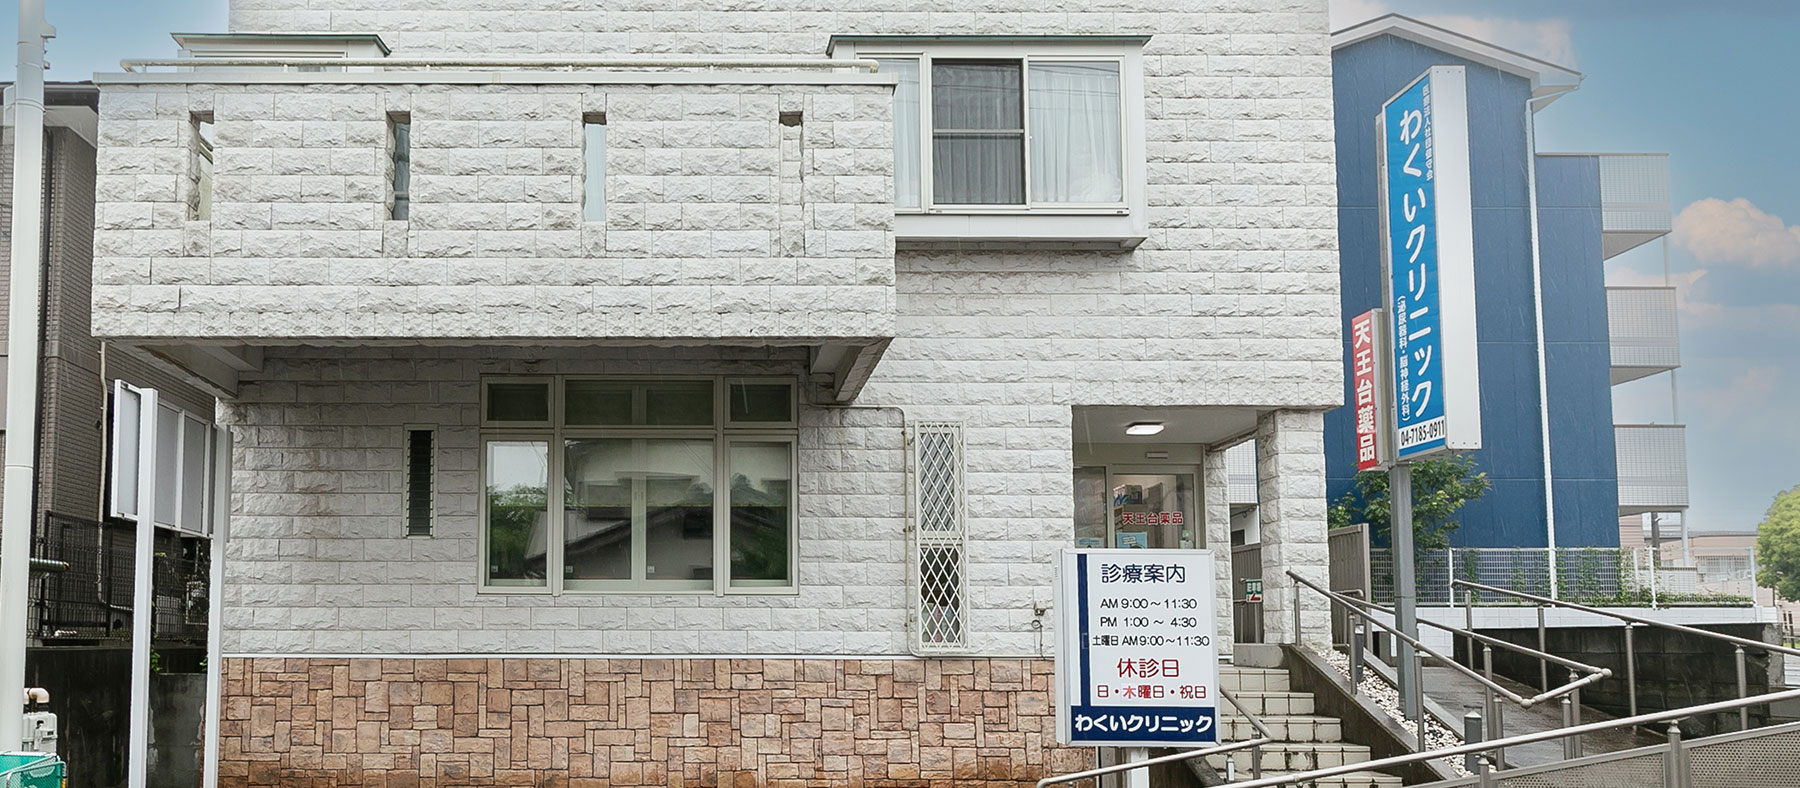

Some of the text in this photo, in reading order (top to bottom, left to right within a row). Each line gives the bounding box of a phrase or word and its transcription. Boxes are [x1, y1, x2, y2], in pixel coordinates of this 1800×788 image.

[1400, 110, 1432, 417] わくいクリニック
[1354, 319, 1375, 462] 天王台薬品
[1401, 420, 1445, 446] 04-7185-0911
[1122, 511, 1184, 526] 天王台薬品
[1101, 564, 1186, 584] 診療案内
[1100, 599, 1118, 609] AM
[1100, 617, 1118, 627] PM
[1092, 636, 1119, 646] 土曜日
[1117, 658, 1180, 678] 休診日
[1097, 685, 1207, 699] 日・木曜日・祝日
[1075, 714, 1213, 732] わくいクリニック
